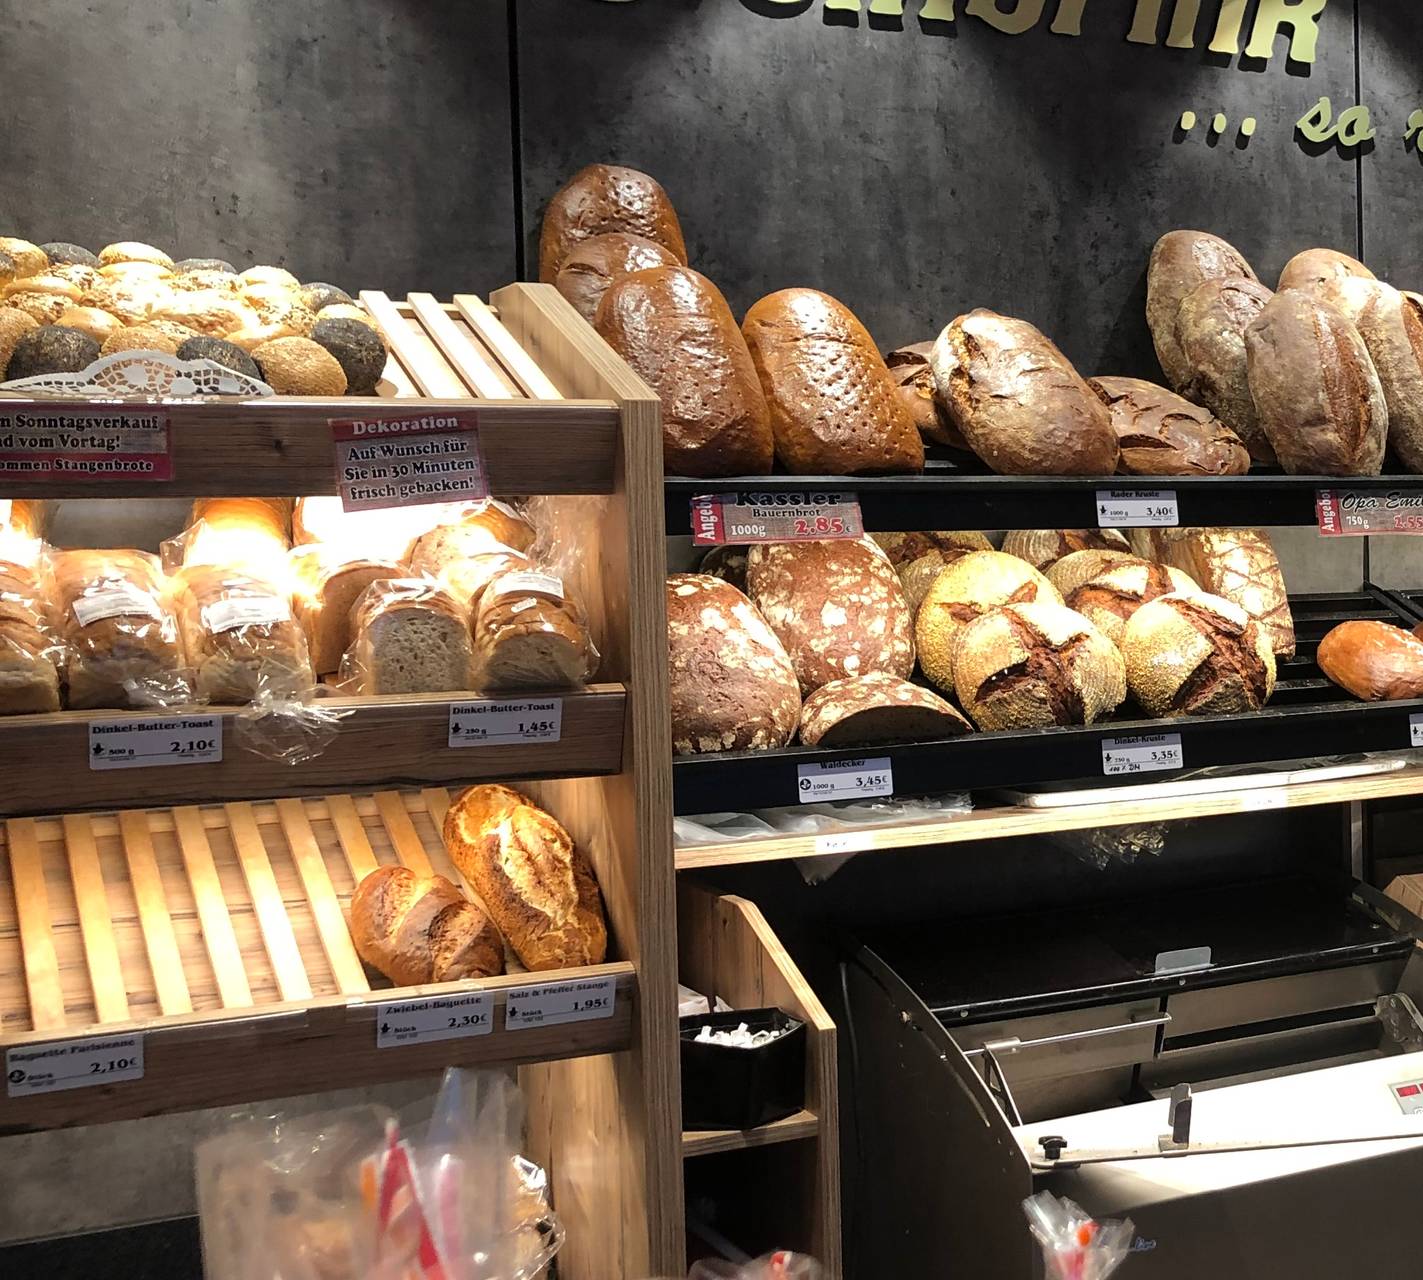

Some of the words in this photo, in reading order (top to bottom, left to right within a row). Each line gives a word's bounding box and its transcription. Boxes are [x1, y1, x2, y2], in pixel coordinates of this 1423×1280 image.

[1296, 96, 1376, 146] so
[15, 414, 158, 431] Sonntagsverkauf
[352, 416, 458, 435] Dekoration
[19, 437, 54, 448] vom
[58, 434, 121, 451] Vortag!
[348, 446, 377, 461] Auf
[379, 441, 440, 457] Wunsch
[442, 439, 467, 452] für
[54, 458, 153, 472] Stangenbrote
[344, 468, 368, 480] Sie
[371, 466, 387, 478] in
[390, 465, 409, 478] 30
[412, 459, 475, 475] Minuten
[350, 482, 396, 500] frisch
[400, 477, 474, 498] gebacken!
[735, 491, 841, 506] Kassler
[1342, 492, 1378, 513] Opa
[752, 509, 821, 518] Bauernbrot
[731, 525, 766, 537] 1000g
[795, 516, 844, 535] 2.85
[452, 703, 555, 715] Dinkel-Butter-Toast
[92, 720, 214, 735] Dinkel-Butter-Toast
[518, 721, 555, 734] 1,45€
[170, 740, 216, 754] 2,10€
[819, 759, 866, 769] Waldecker
[856, 775, 888, 788] 3,45€
[572, 996, 609, 1013] 1,95€
[447, 1014, 488, 1030] 2,30€
[90, 1056, 137, 1074] 2,10€
